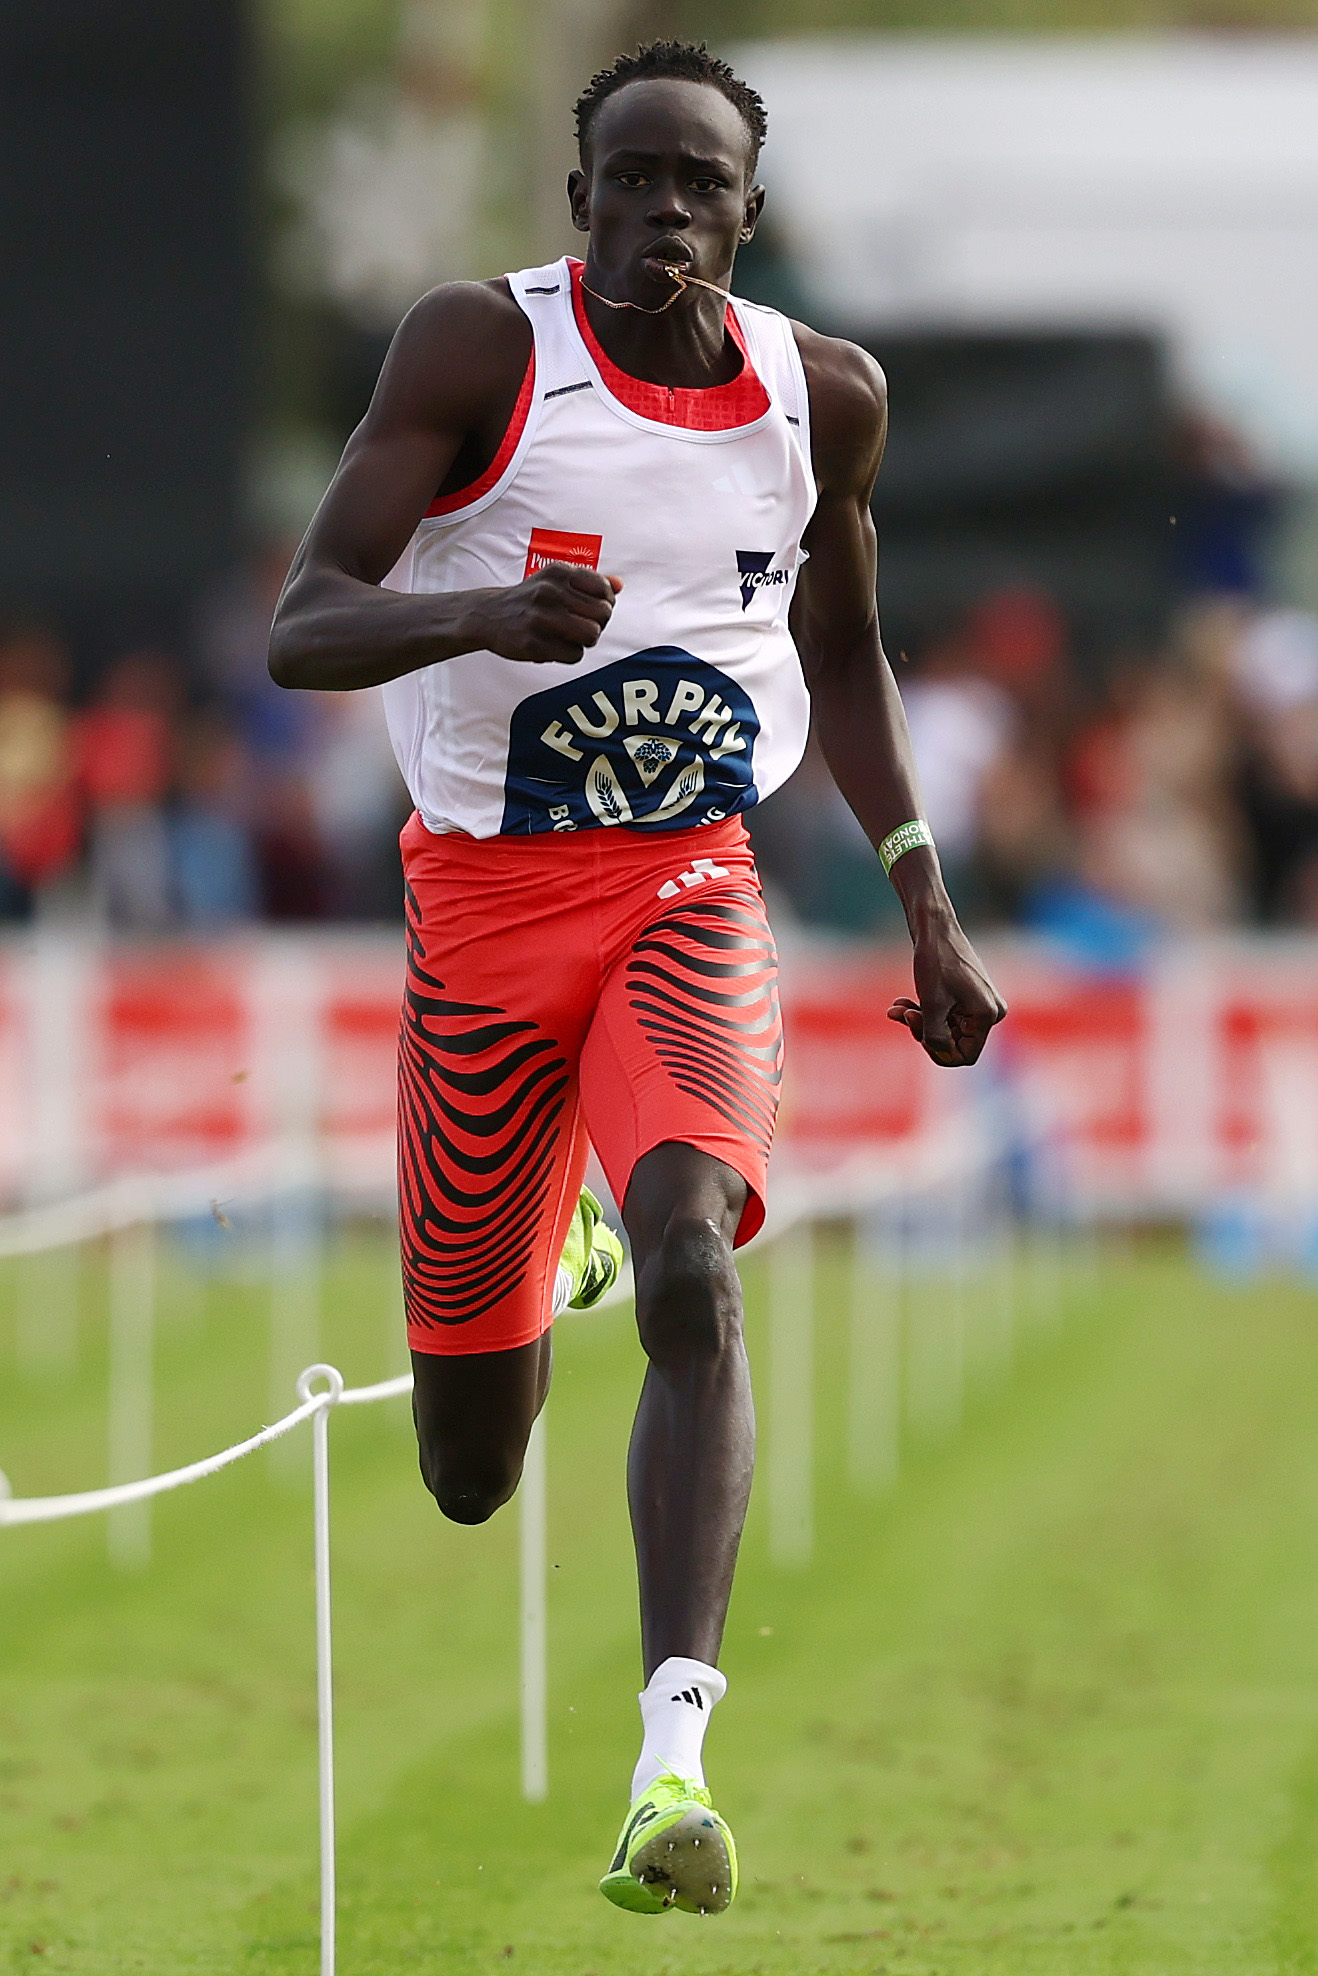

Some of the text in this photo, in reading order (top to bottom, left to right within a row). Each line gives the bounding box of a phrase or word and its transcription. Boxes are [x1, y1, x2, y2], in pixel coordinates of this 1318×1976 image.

[540, 679, 747, 762] FURPHY
[883, 824, 920, 856] ONDAY
[886, 833, 927, 865] THLETE
